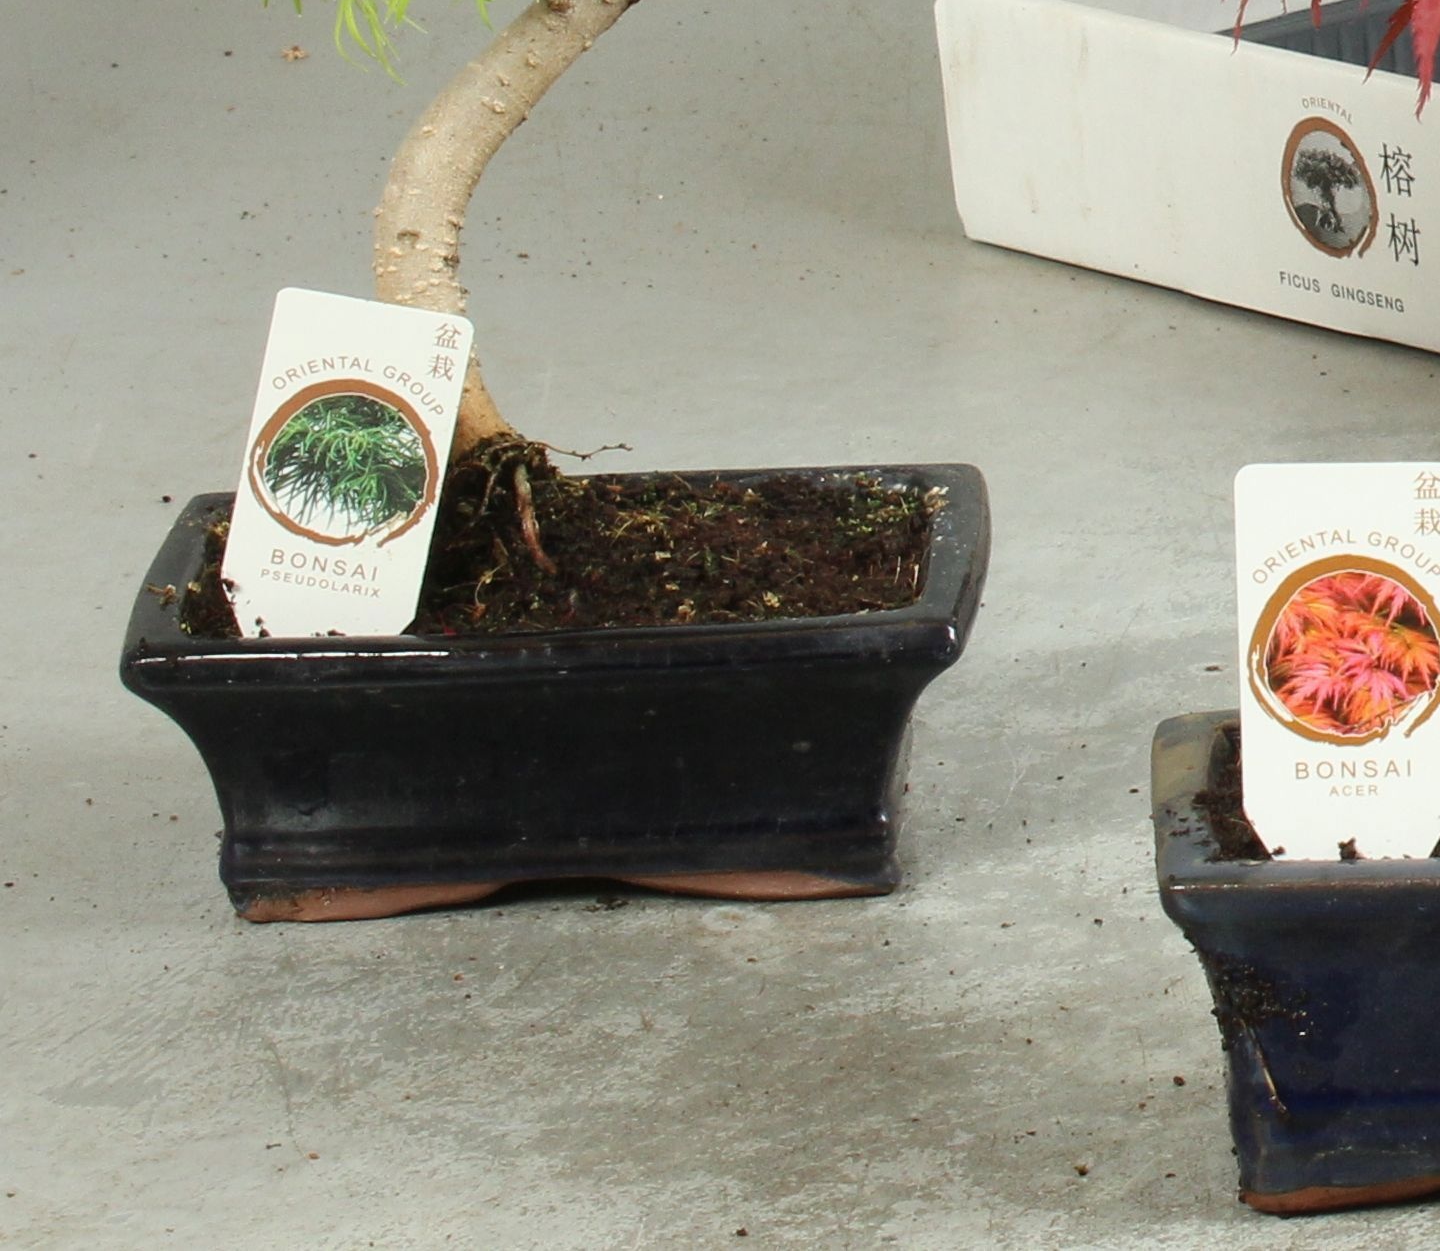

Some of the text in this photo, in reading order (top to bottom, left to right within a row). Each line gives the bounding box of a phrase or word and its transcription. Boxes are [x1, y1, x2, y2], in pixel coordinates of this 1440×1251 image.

[1301, 97, 1353, 125] ORIENTAL
[1378, 142, 1420, 267] 榕树
[1278, 270, 1406, 314] FICUS GINGSENG
[428, 321, 463, 383] 盆栽
[271, 355, 445, 418] ORIENTAL GROUP
[270, 548, 379, 582] BONSAI
[1251, 528, 1358, 586] ORIENTAL
[260, 567, 382, 599] PSEUDOLARIX
[1294, 758, 1413, 781] BONSAI
[1329, 784, 1379, 797] ACER
